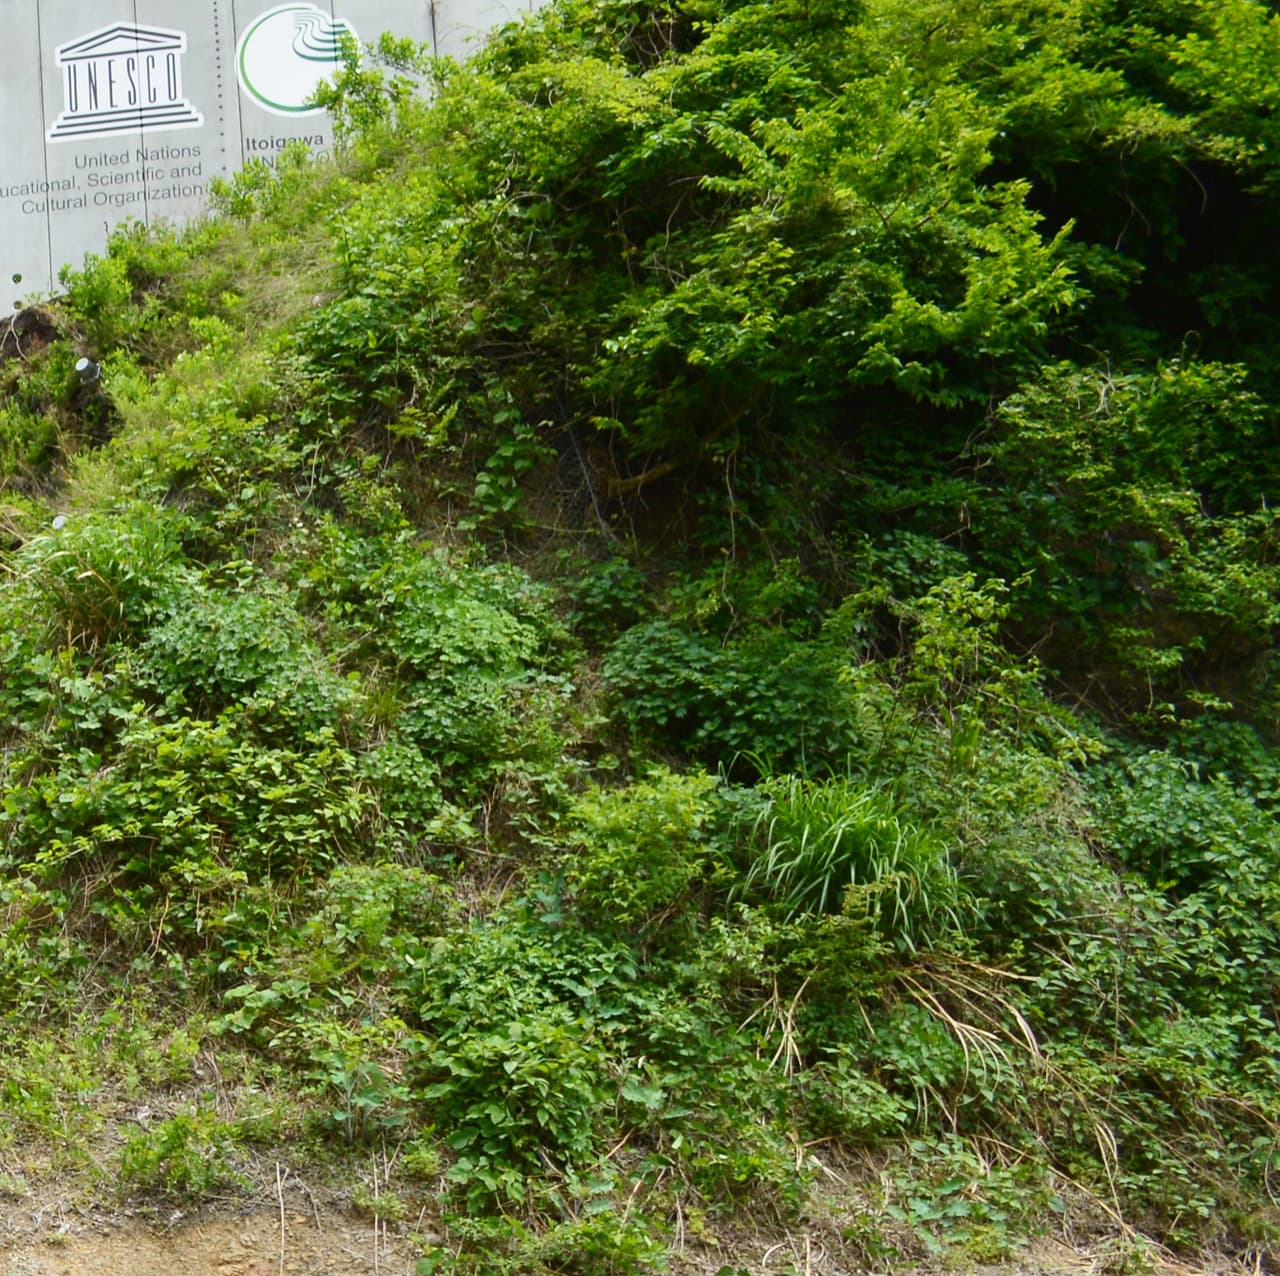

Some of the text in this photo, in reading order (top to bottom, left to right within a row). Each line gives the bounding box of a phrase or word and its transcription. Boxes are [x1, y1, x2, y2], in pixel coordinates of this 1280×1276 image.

[67, 52, 179, 114] UNESCO
[74, 145, 202, 169] United Nations
[87, 167, 165, 188] Scientific
[170, 162, 202, 178] and
[21, 183, 204, 214] Cultural Organization
